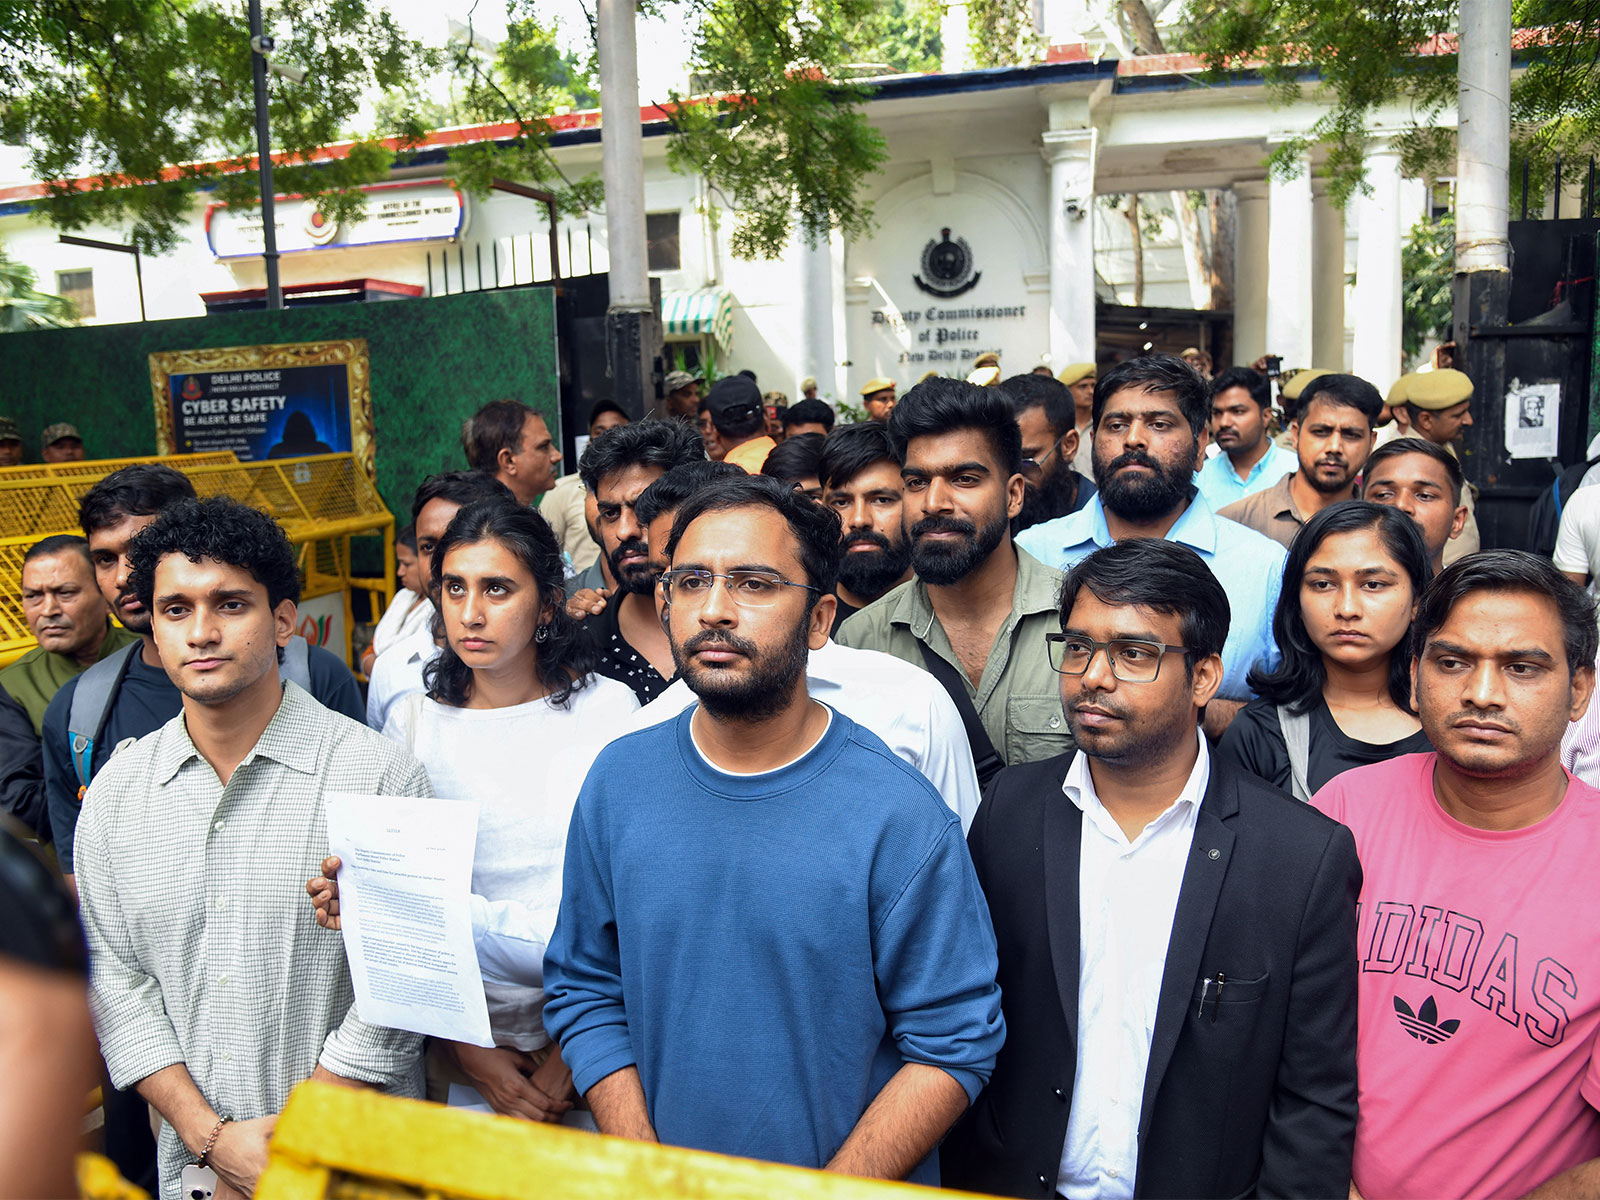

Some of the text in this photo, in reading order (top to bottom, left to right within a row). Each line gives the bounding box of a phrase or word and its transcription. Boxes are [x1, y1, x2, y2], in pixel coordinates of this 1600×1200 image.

[925, 305, 1026, 322] Commissioner
[918, 328, 979, 345] of Police
[211, 371, 281, 385] DELHI POLICE
[181, 395, 286, 415] CYBER SAFETY
[183, 416, 196, 426] BE
[228, 413, 241, 424] BE
[242, 412, 267, 423] SAFE
[1356, 901, 1579, 1049] DIDAS
